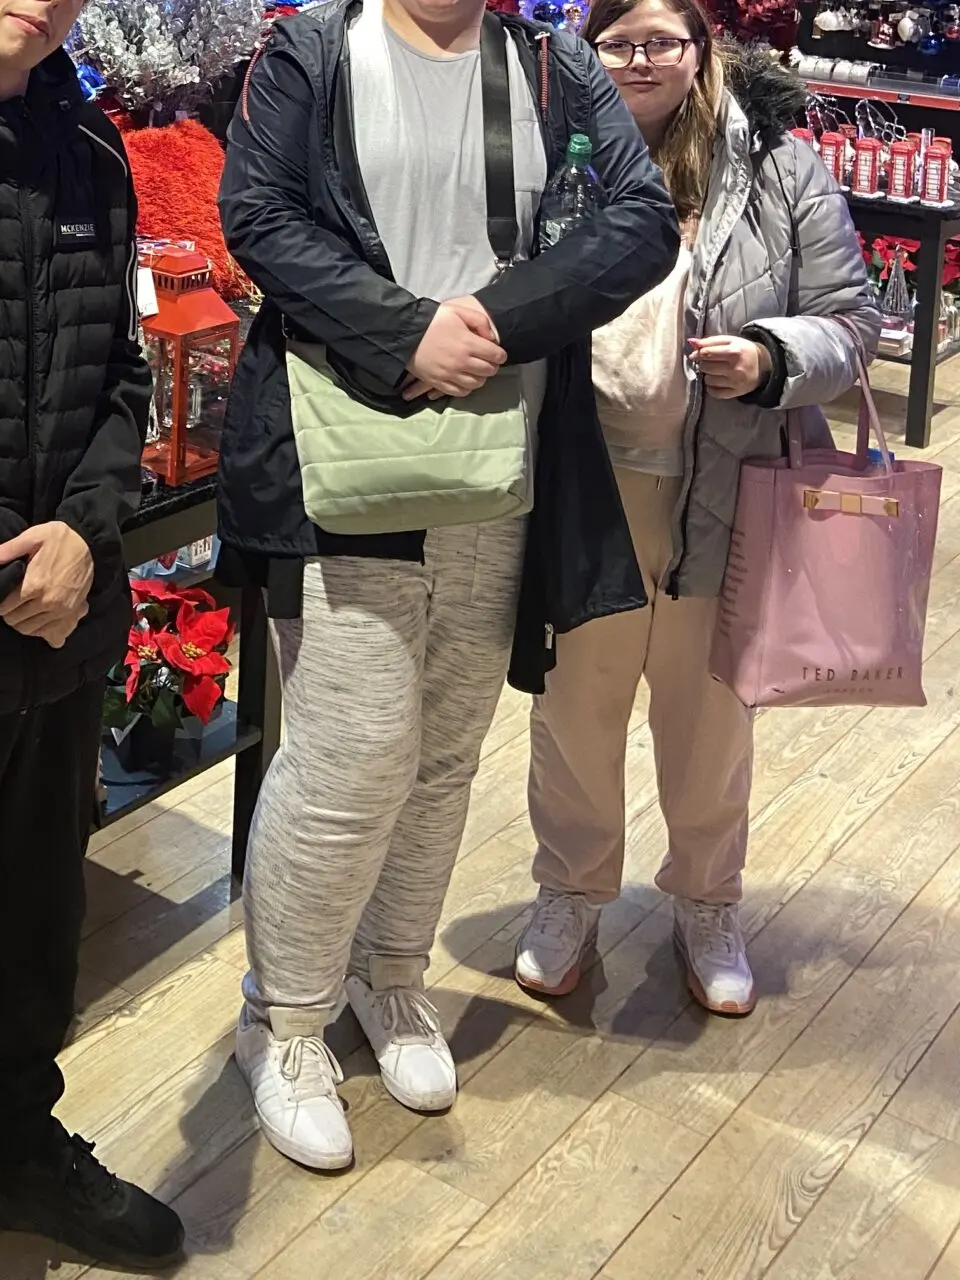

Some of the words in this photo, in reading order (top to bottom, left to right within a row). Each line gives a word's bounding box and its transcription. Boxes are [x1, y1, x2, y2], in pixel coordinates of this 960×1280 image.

[60, 223, 96, 233] MCKENZIE
[802, 666, 836, 682] TED
[850, 666, 904, 682] BAKER
